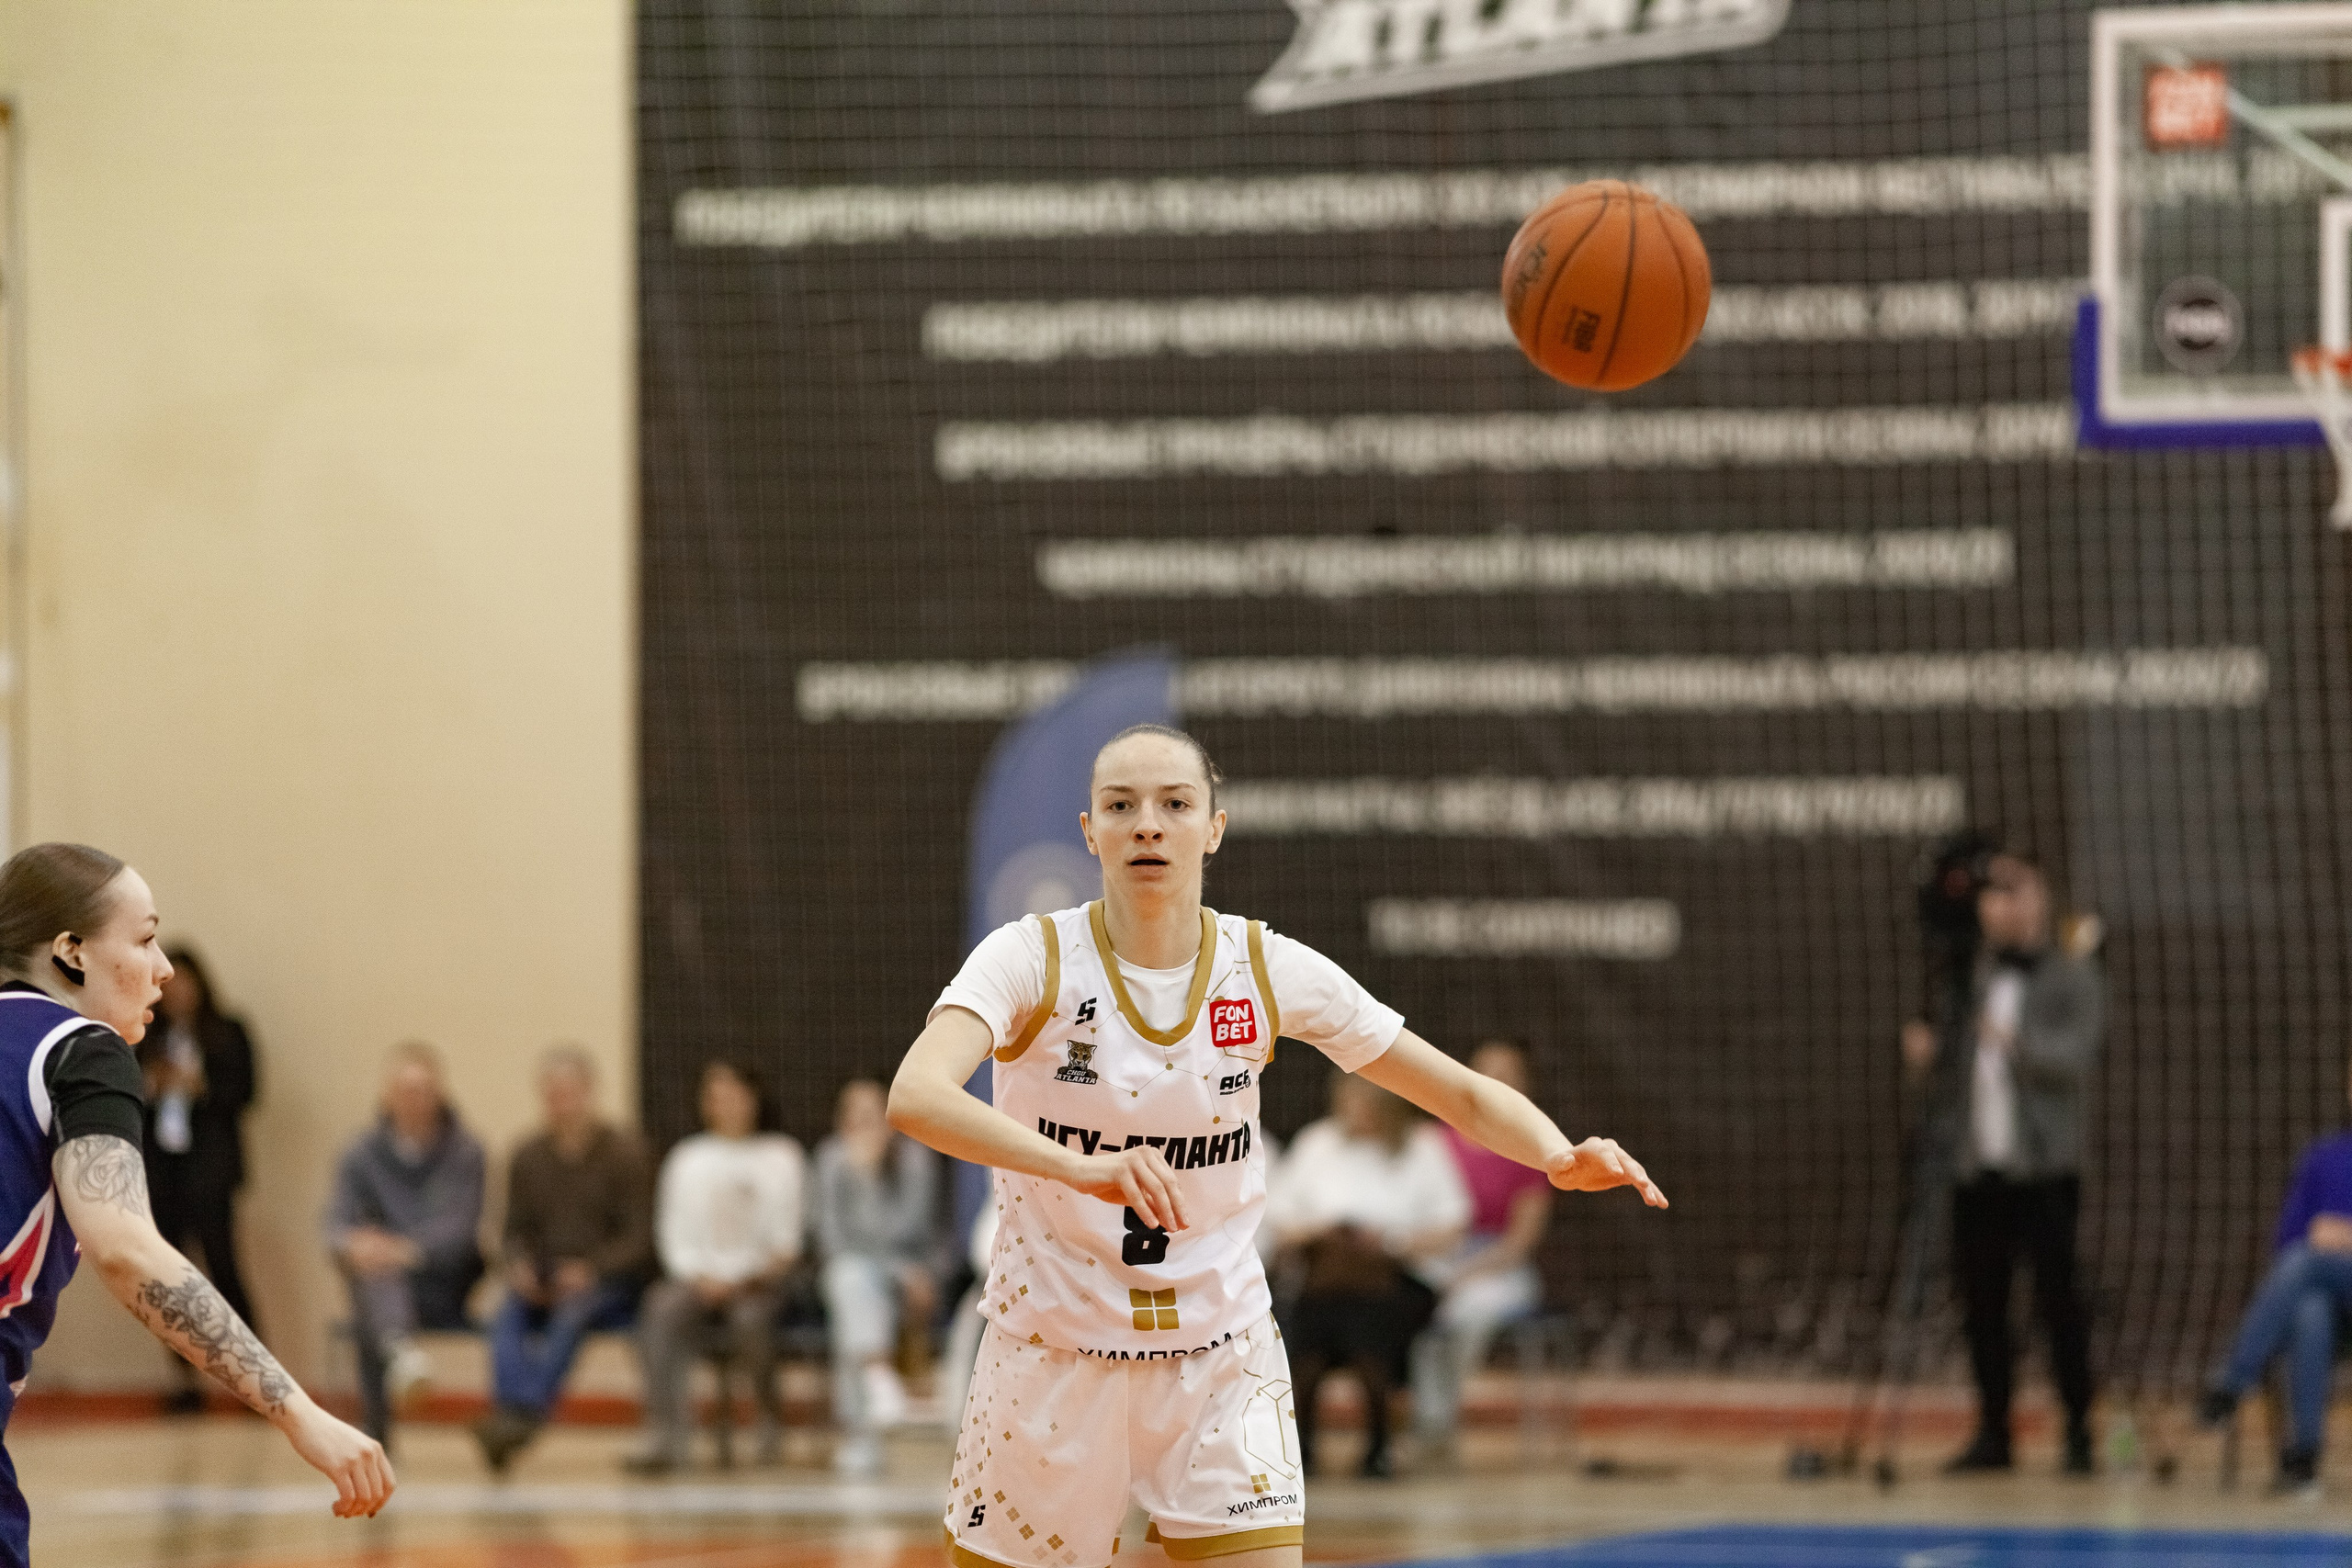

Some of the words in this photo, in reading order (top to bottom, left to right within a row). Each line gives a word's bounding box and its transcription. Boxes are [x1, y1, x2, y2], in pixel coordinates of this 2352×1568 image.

[1214, 1004, 1250, 1023] FON
[1216, 1021, 1253, 1042] BET
[1056, 1073, 1097, 1084] ATLANTA
[1227, 1494, 1297, 1517] ХИМПРОМ
